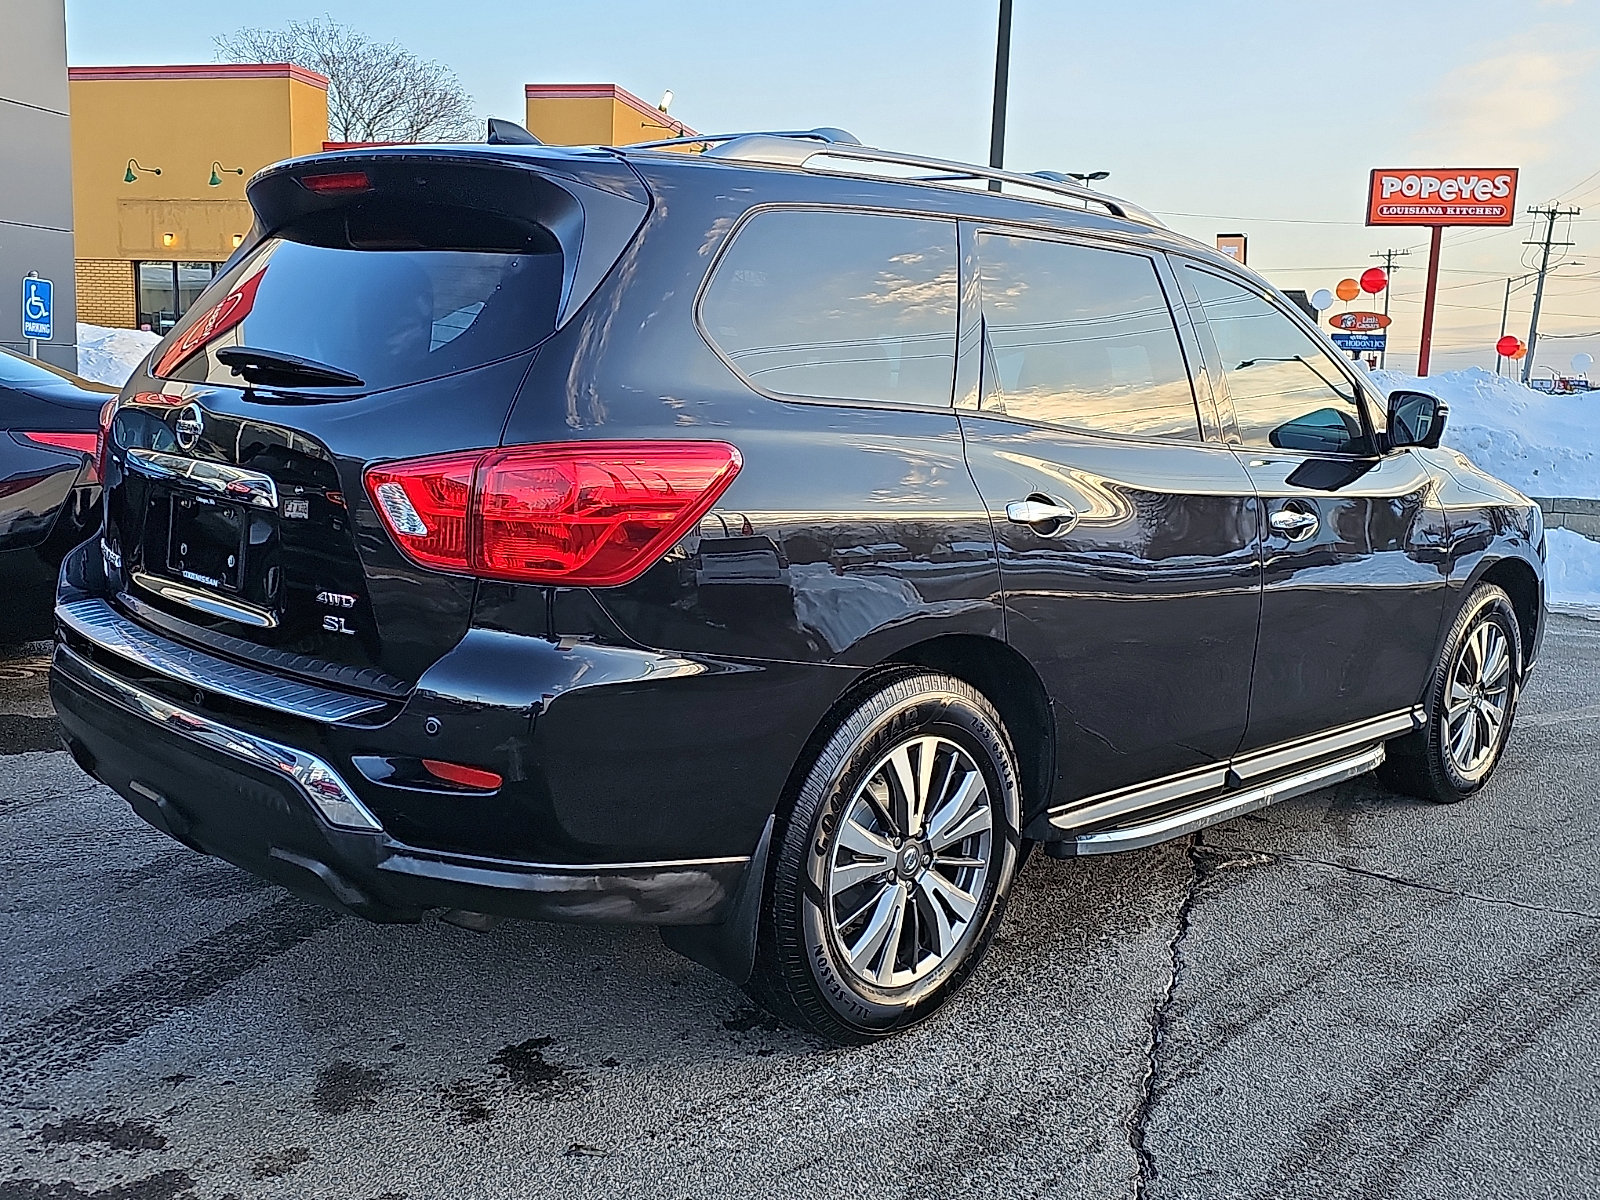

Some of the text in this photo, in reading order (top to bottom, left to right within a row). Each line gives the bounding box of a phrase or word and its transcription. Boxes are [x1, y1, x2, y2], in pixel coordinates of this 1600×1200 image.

[1382, 206, 1502, 215] LOUISIANA KITCHEN
[25, 321, 50, 334] PARKING
[322, 615, 356, 635] SL
[813, 943, 872, 1019] ALL-SEASON
